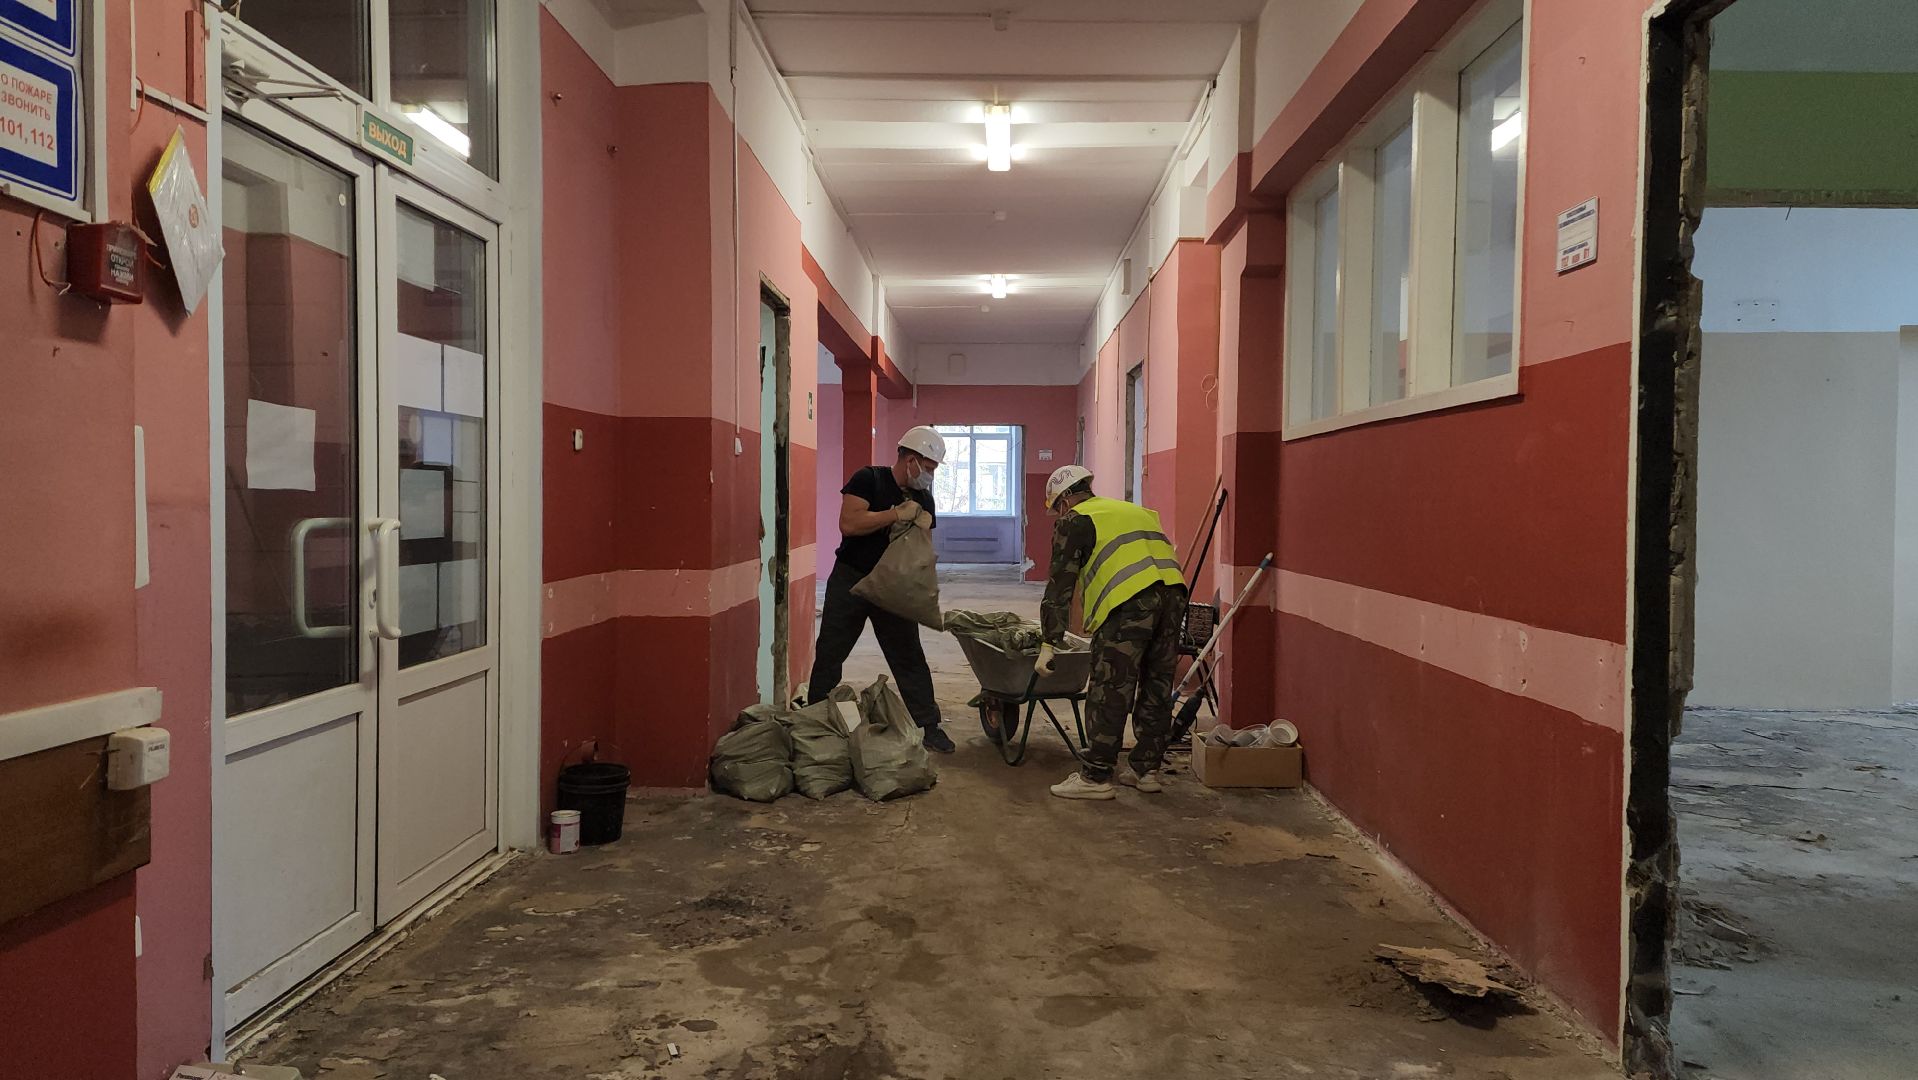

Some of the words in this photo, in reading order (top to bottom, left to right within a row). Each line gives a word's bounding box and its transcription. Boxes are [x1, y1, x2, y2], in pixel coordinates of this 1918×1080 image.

[0, 73, 9, 85] О
[11, 78, 53, 105] ПОЖАРЕ
[1, 90, 51, 121] ЗВОНИТЬ
[368, 121, 407, 159] ВЫХОД
